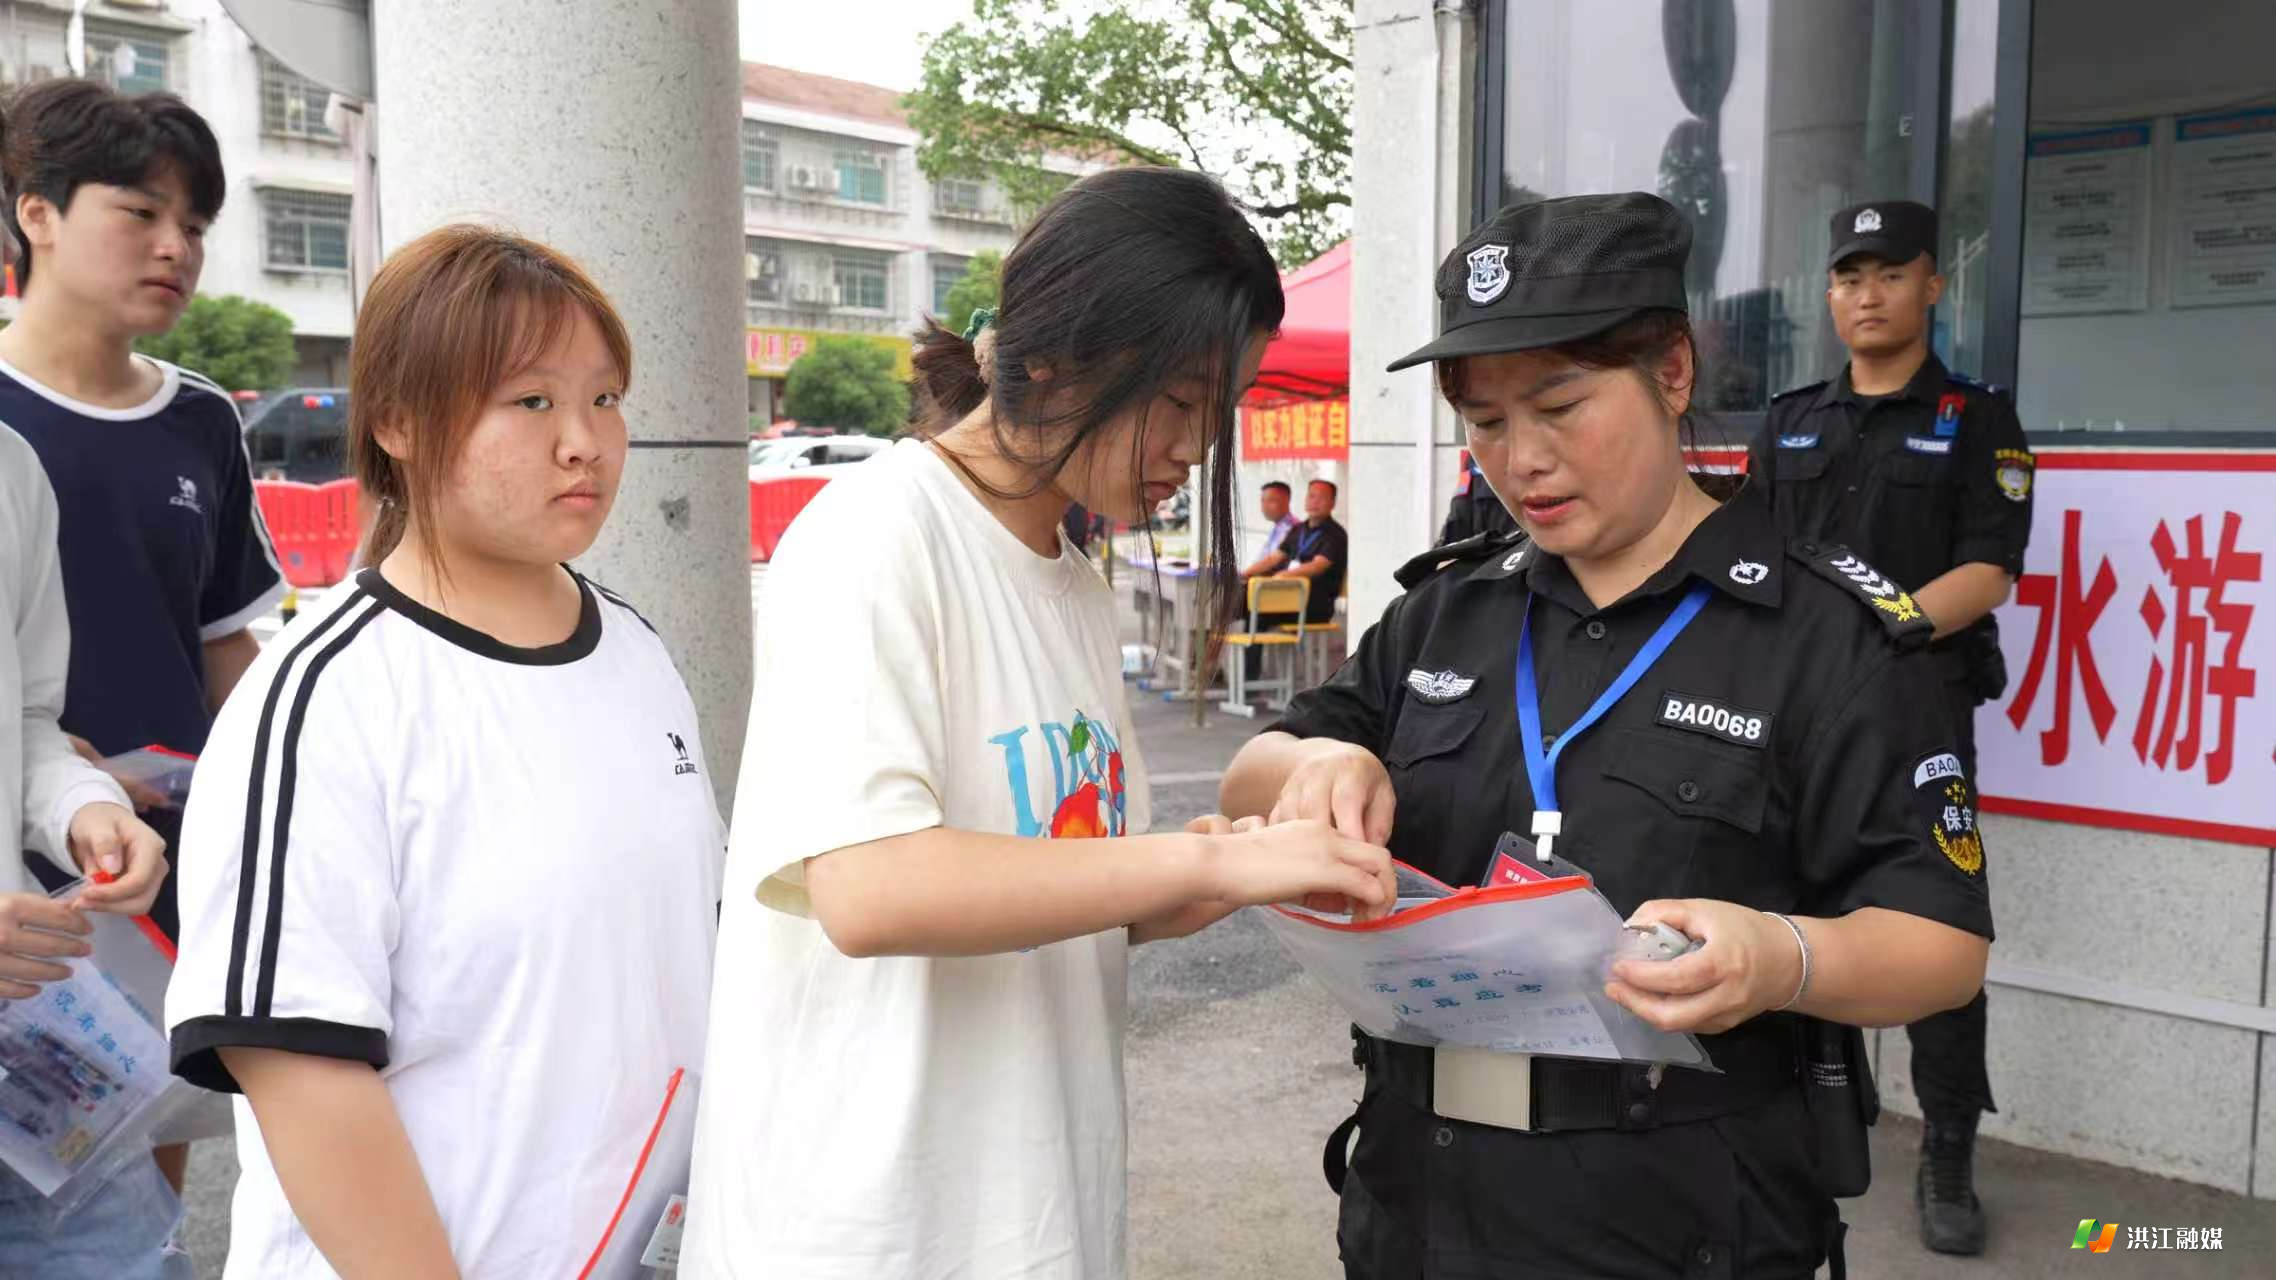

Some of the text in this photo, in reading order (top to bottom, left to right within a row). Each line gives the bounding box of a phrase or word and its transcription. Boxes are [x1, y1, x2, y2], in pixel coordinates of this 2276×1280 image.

[2006, 509, 2276, 786] 水游
[1663, 699, 1763, 740] BA0068
[1942, 805, 1974, 832] 保安
